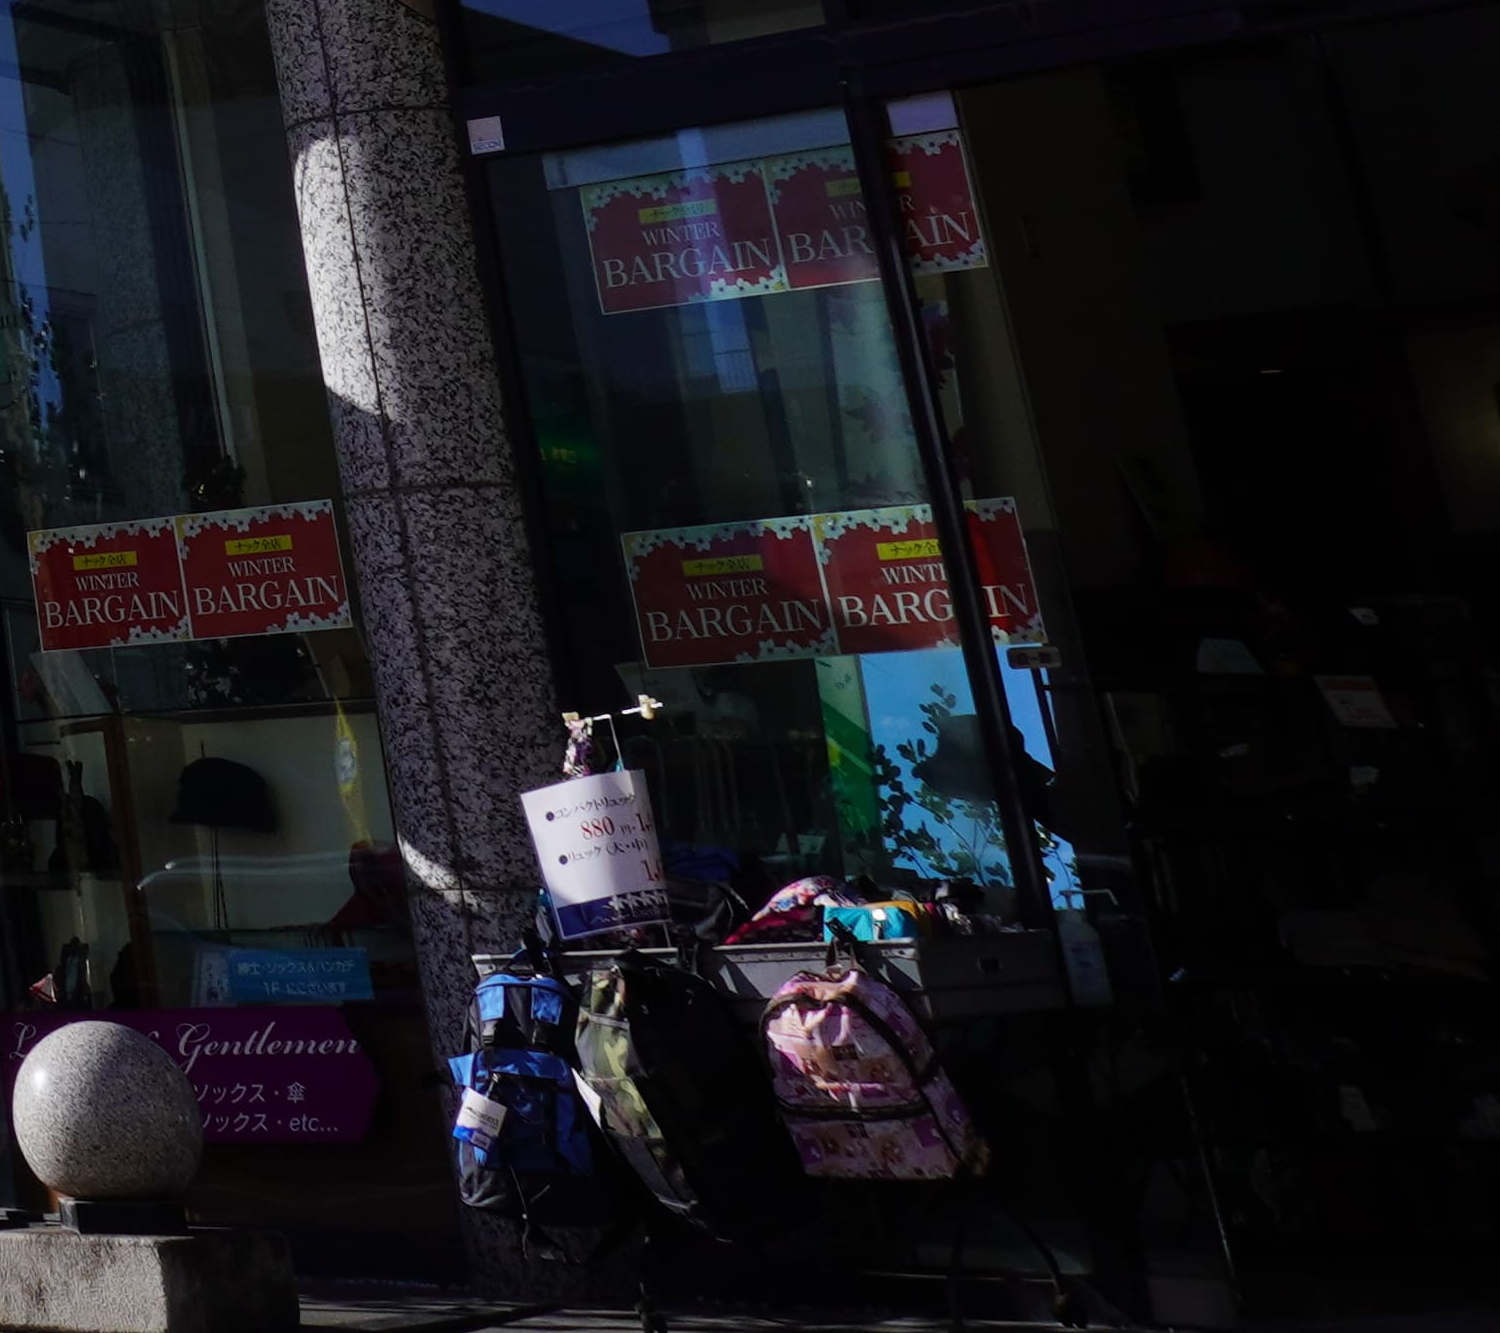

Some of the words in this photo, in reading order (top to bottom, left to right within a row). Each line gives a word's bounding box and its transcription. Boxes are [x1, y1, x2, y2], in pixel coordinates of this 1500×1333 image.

[641, 221, 721, 246] WINTER
[791, 211, 973, 264] BARAIN
[603, 237, 774, 289] BARGAIN
[75, 571, 140, 592] WINTER
[228, 555, 297, 578] WINTER
[193, 575, 342, 616] BARGAIN
[685, 578, 770, 601] WINTER
[837, 583, 1031, 628] BARGIN
[43, 590, 180, 630] BARGAIN
[646, 597, 822, 644] BARGAIN
[581, 816, 615, 841] 880
[176, 1021, 359, 1075] Gentlemen
